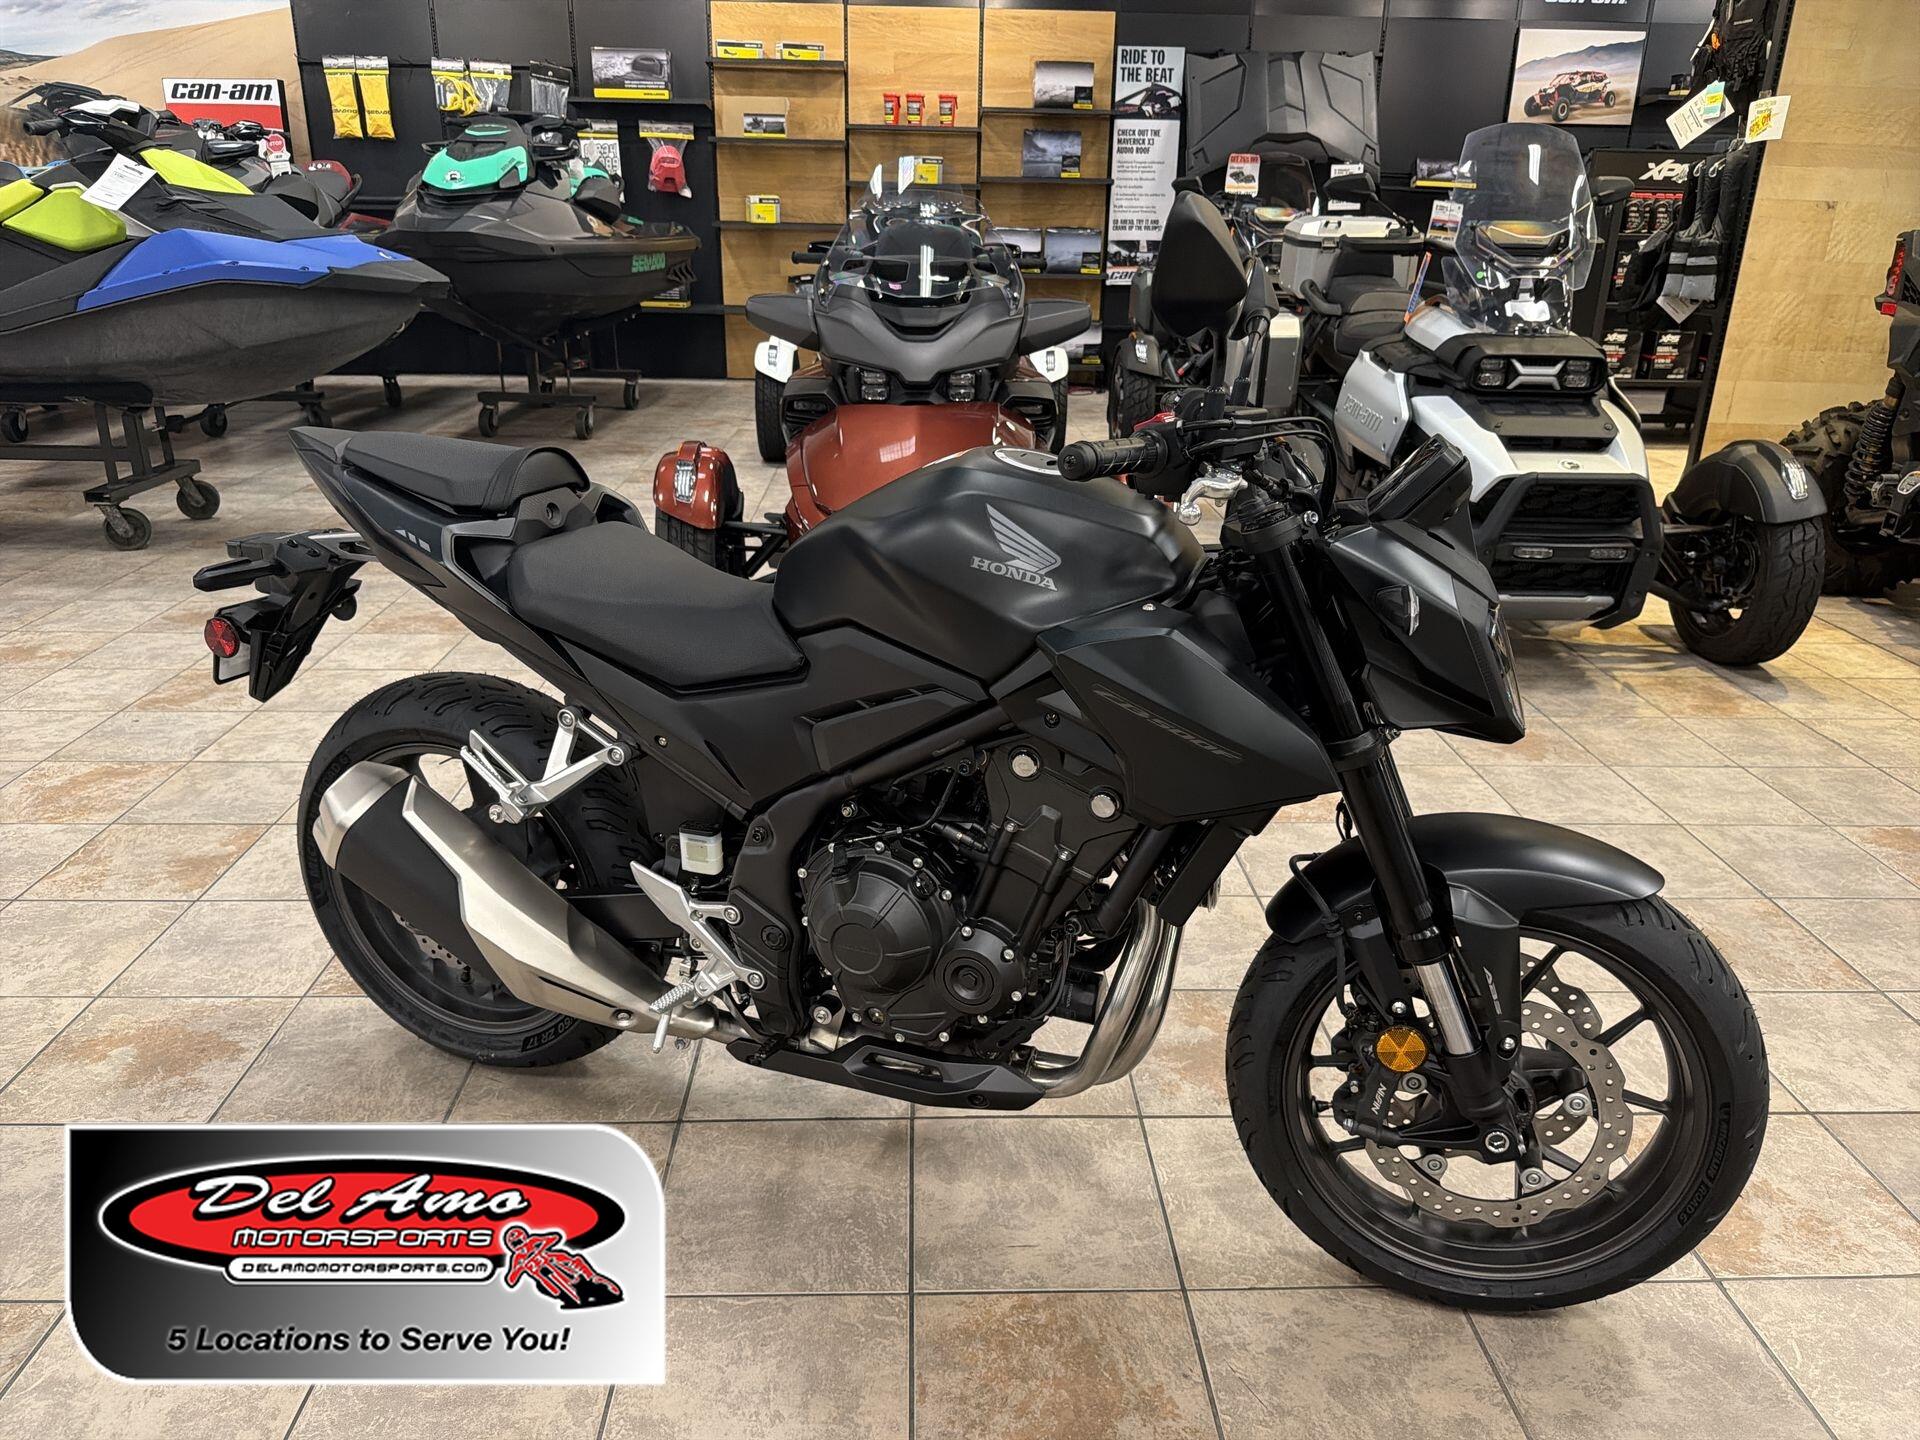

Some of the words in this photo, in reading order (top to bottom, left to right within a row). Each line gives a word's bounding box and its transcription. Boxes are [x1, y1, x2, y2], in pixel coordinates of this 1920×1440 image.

[1121, 49, 1147, 64] RIDE
[1151, 49, 1165, 65] TO
[1120, 67, 1141, 82] THE
[1145, 68, 1174, 83] BEAT
[171, 83, 273, 101] can-am
[1117, 128, 1136, 137] CHECK
[1137, 129, 1148, 137] OUT
[1150, 129, 1160, 137] THE
[1117, 138, 1145, 146] MAVERICK
[1147, 138, 1154, 146] X3
[1117, 146, 1134, 154] AUDIO
[970, 556, 1057, 591] HONDA
[1371, 1082, 1387, 1115] NISSIN
